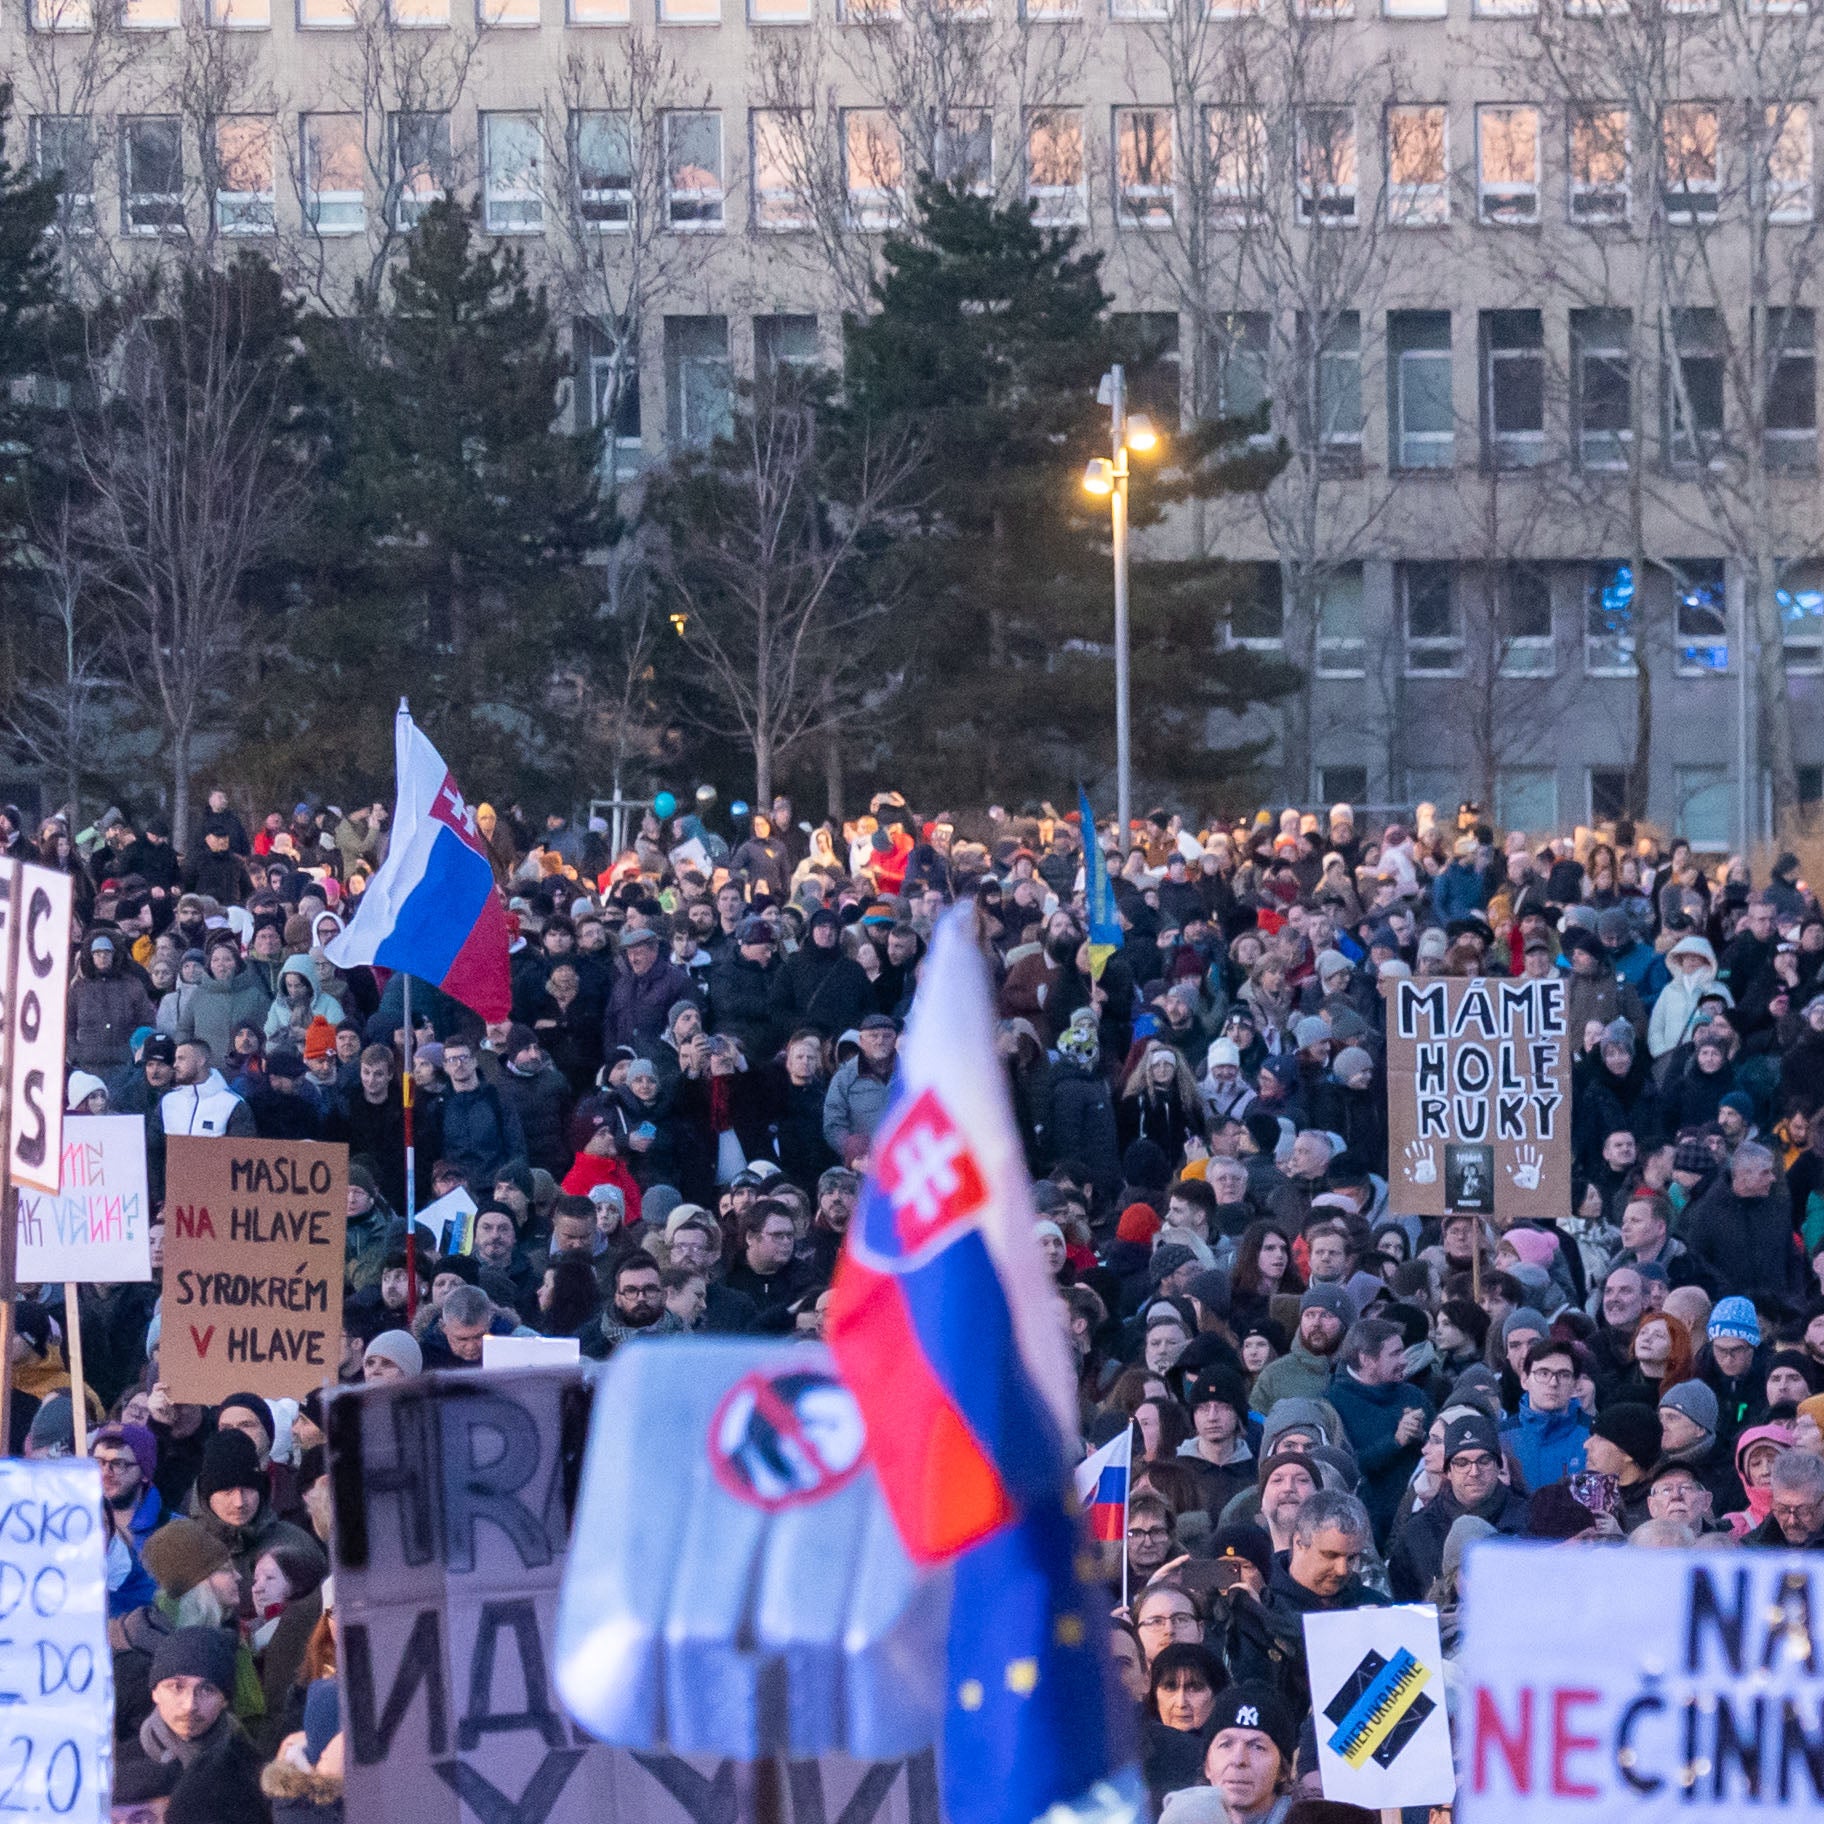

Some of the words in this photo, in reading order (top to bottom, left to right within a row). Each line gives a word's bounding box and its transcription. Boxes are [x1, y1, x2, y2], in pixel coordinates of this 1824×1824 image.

[1399, 978, 1566, 1040] MÁME
[1416, 1037, 1560, 1097] HOLÉ
[1417, 1093, 1563, 1142] RUKY
[230, 1156, 331, 1195] MASLO
[175, 1205, 216, 1239] NA
[231, 1206, 331, 1244] HLAVE
[190, 1325, 216, 1358] V
[228, 1325, 326, 1365] HLAVE
[1337, 1720, 1374, 1761] MIER
[1363, 1655, 1423, 1726] UKRAJINE
